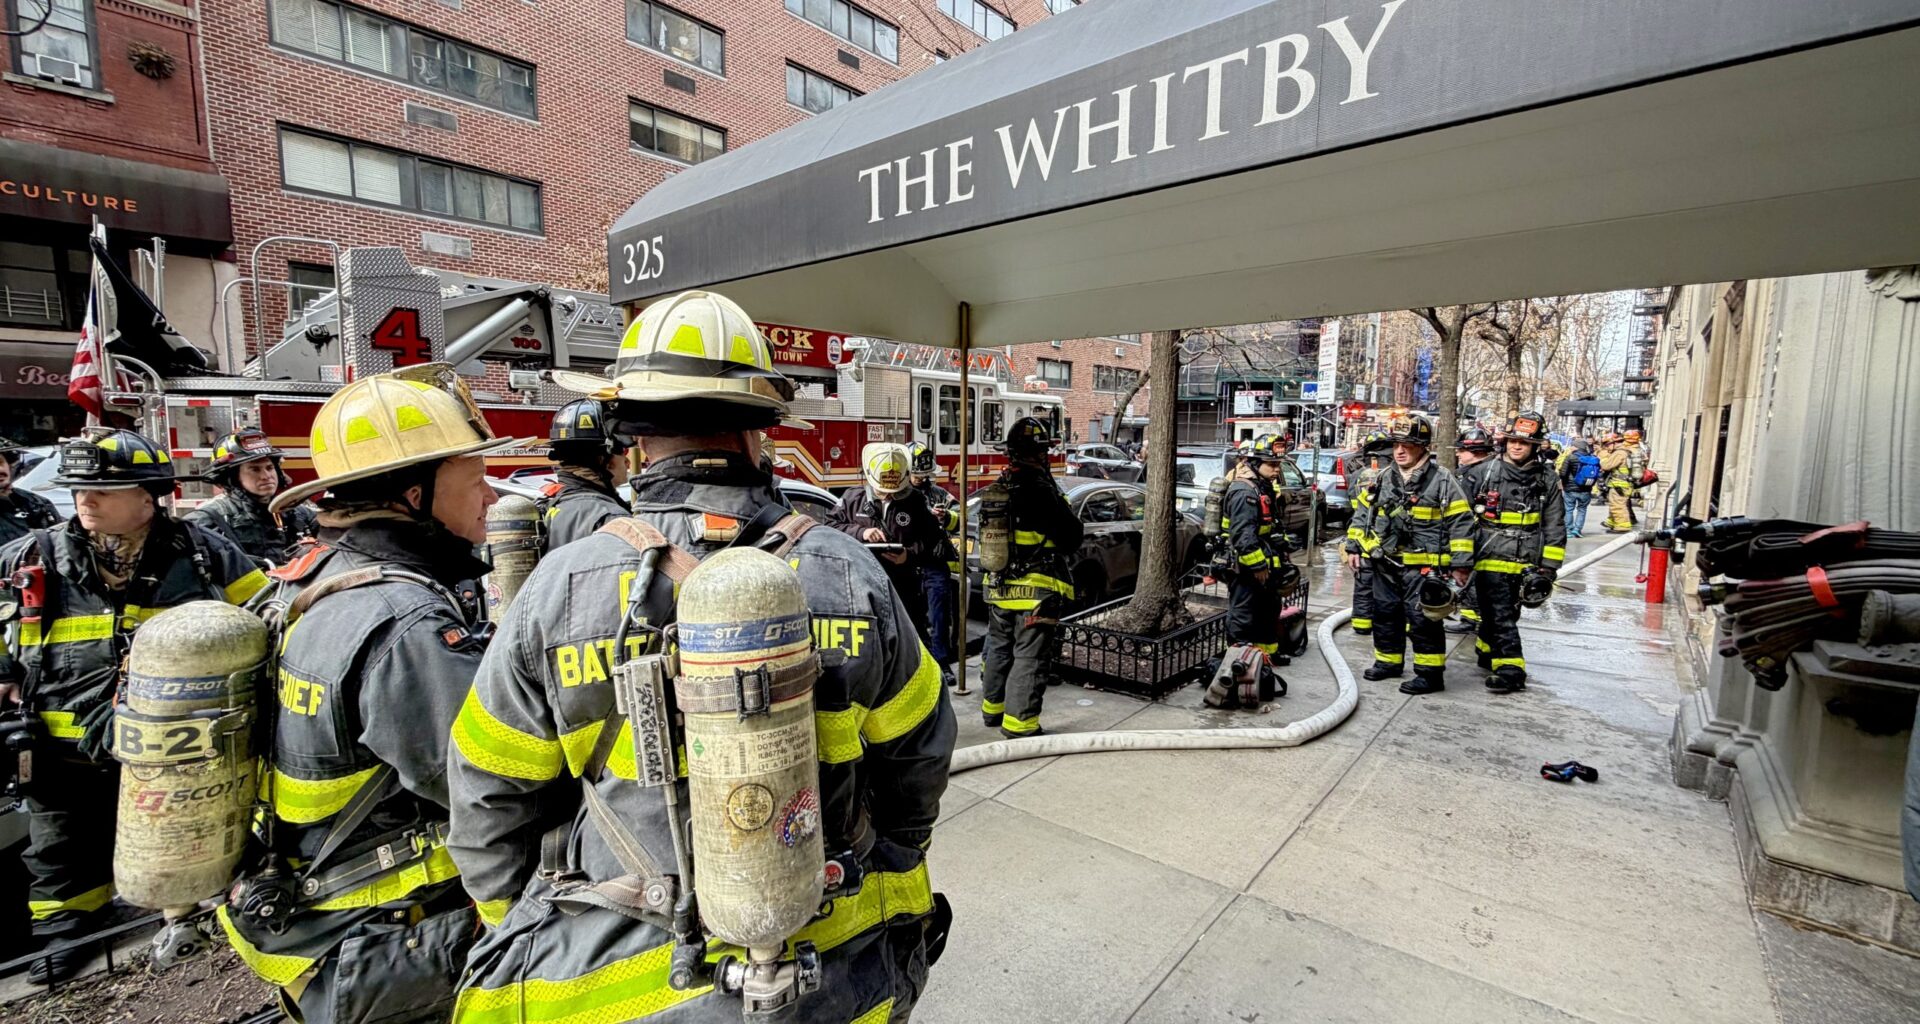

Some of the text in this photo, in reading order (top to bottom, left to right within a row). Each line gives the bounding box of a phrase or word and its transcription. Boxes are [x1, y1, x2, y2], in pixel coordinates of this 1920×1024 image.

[858, 0, 1401, 224] THE WHITBY
[0, 181, 138, 213] CULTURE
[623, 235, 665, 284] 325
[370, 306, 432, 368] 4
[511, 336, 542, 350] 100
[17, 365, 72, 386] Bee
[868, 425, 883, 433] FAST
[714, 626, 743, 639] ST7
[812, 618, 870, 657] IEF
[556, 634, 656, 688] BATT
[120, 725, 202, 756] B-2
[171, 774, 249, 803] SCOTT
